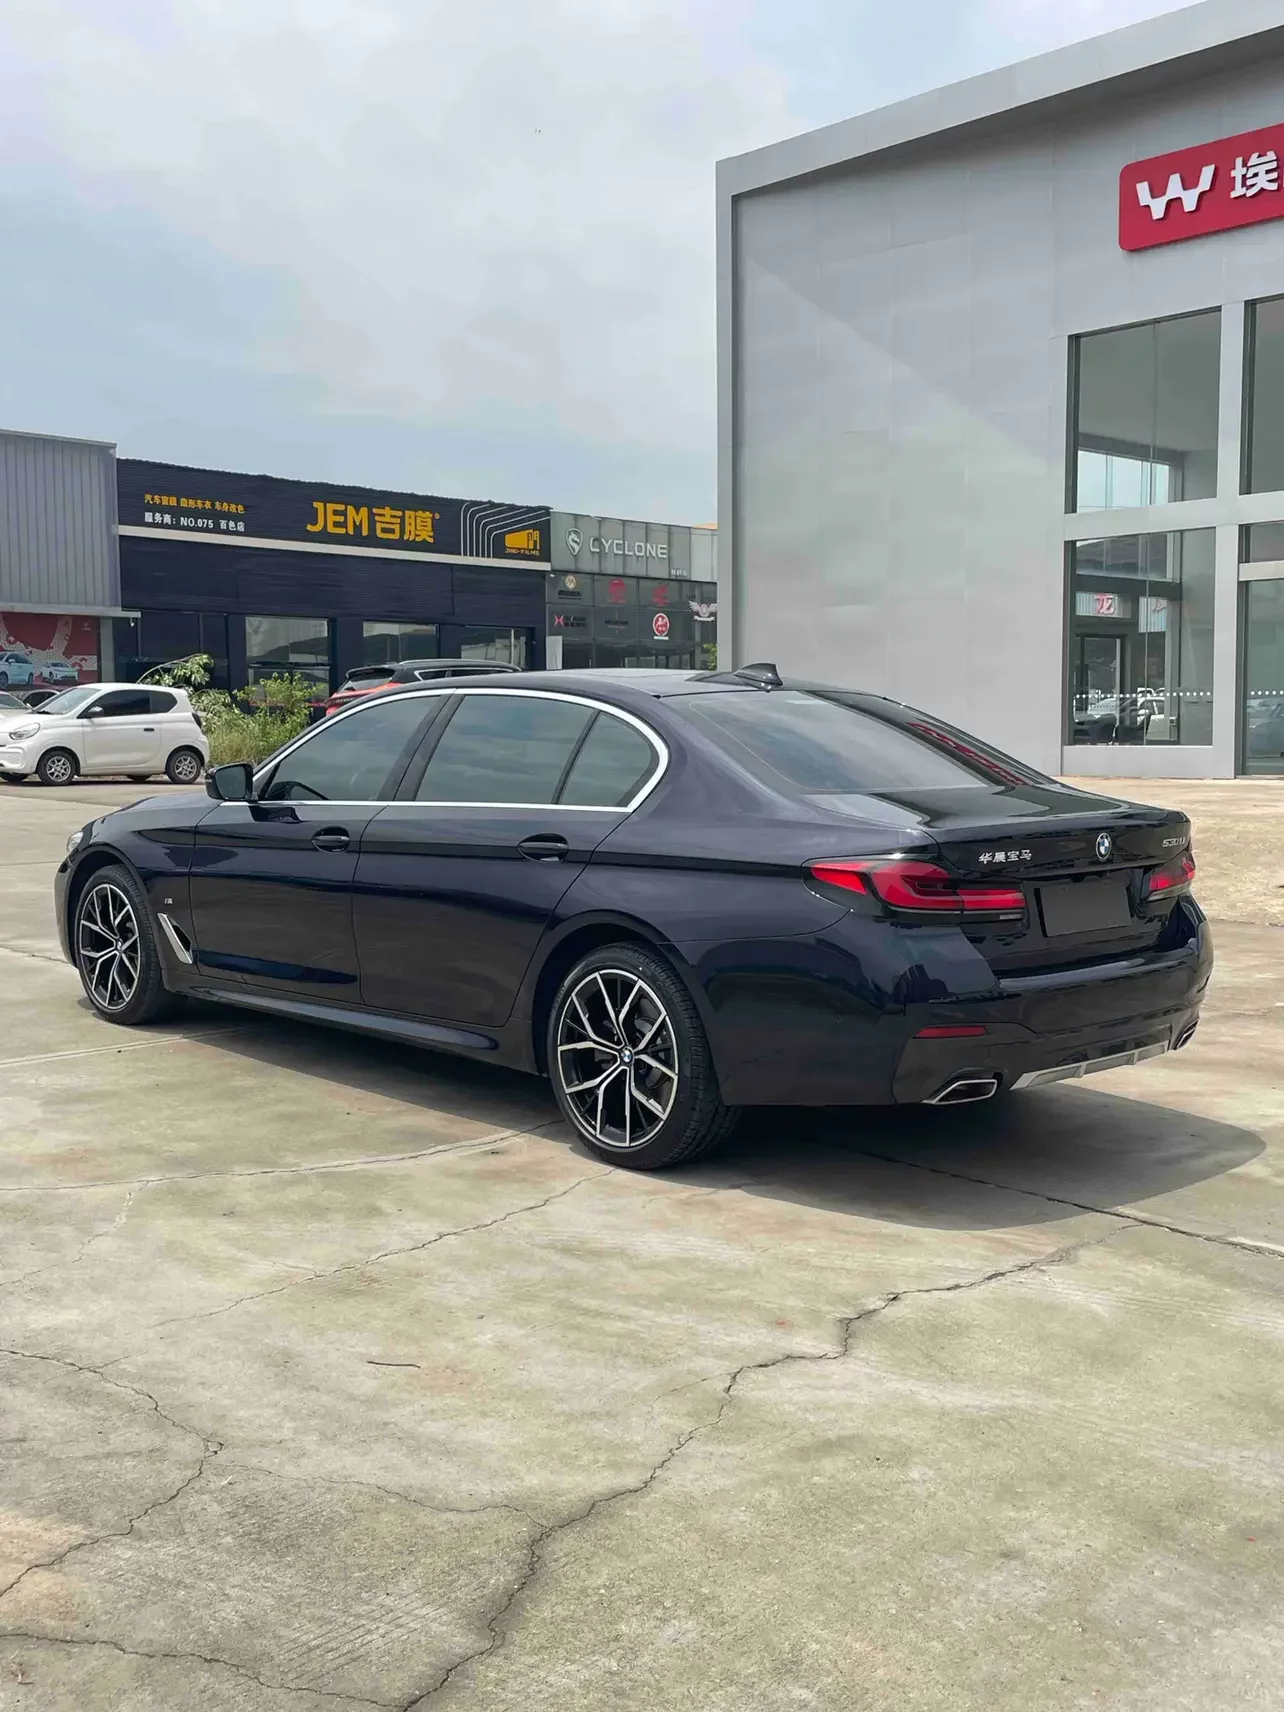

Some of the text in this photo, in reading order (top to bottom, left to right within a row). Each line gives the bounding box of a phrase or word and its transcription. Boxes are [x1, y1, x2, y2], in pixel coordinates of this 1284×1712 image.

[180, 517, 214, 529] NO.075
[219, 519, 246, 532] 百色店
[306, 501, 436, 544] JEM 吉膜
[589, 537, 669, 559] CYCLONE
[979, 849, 1032, 864] 华晨宝马
